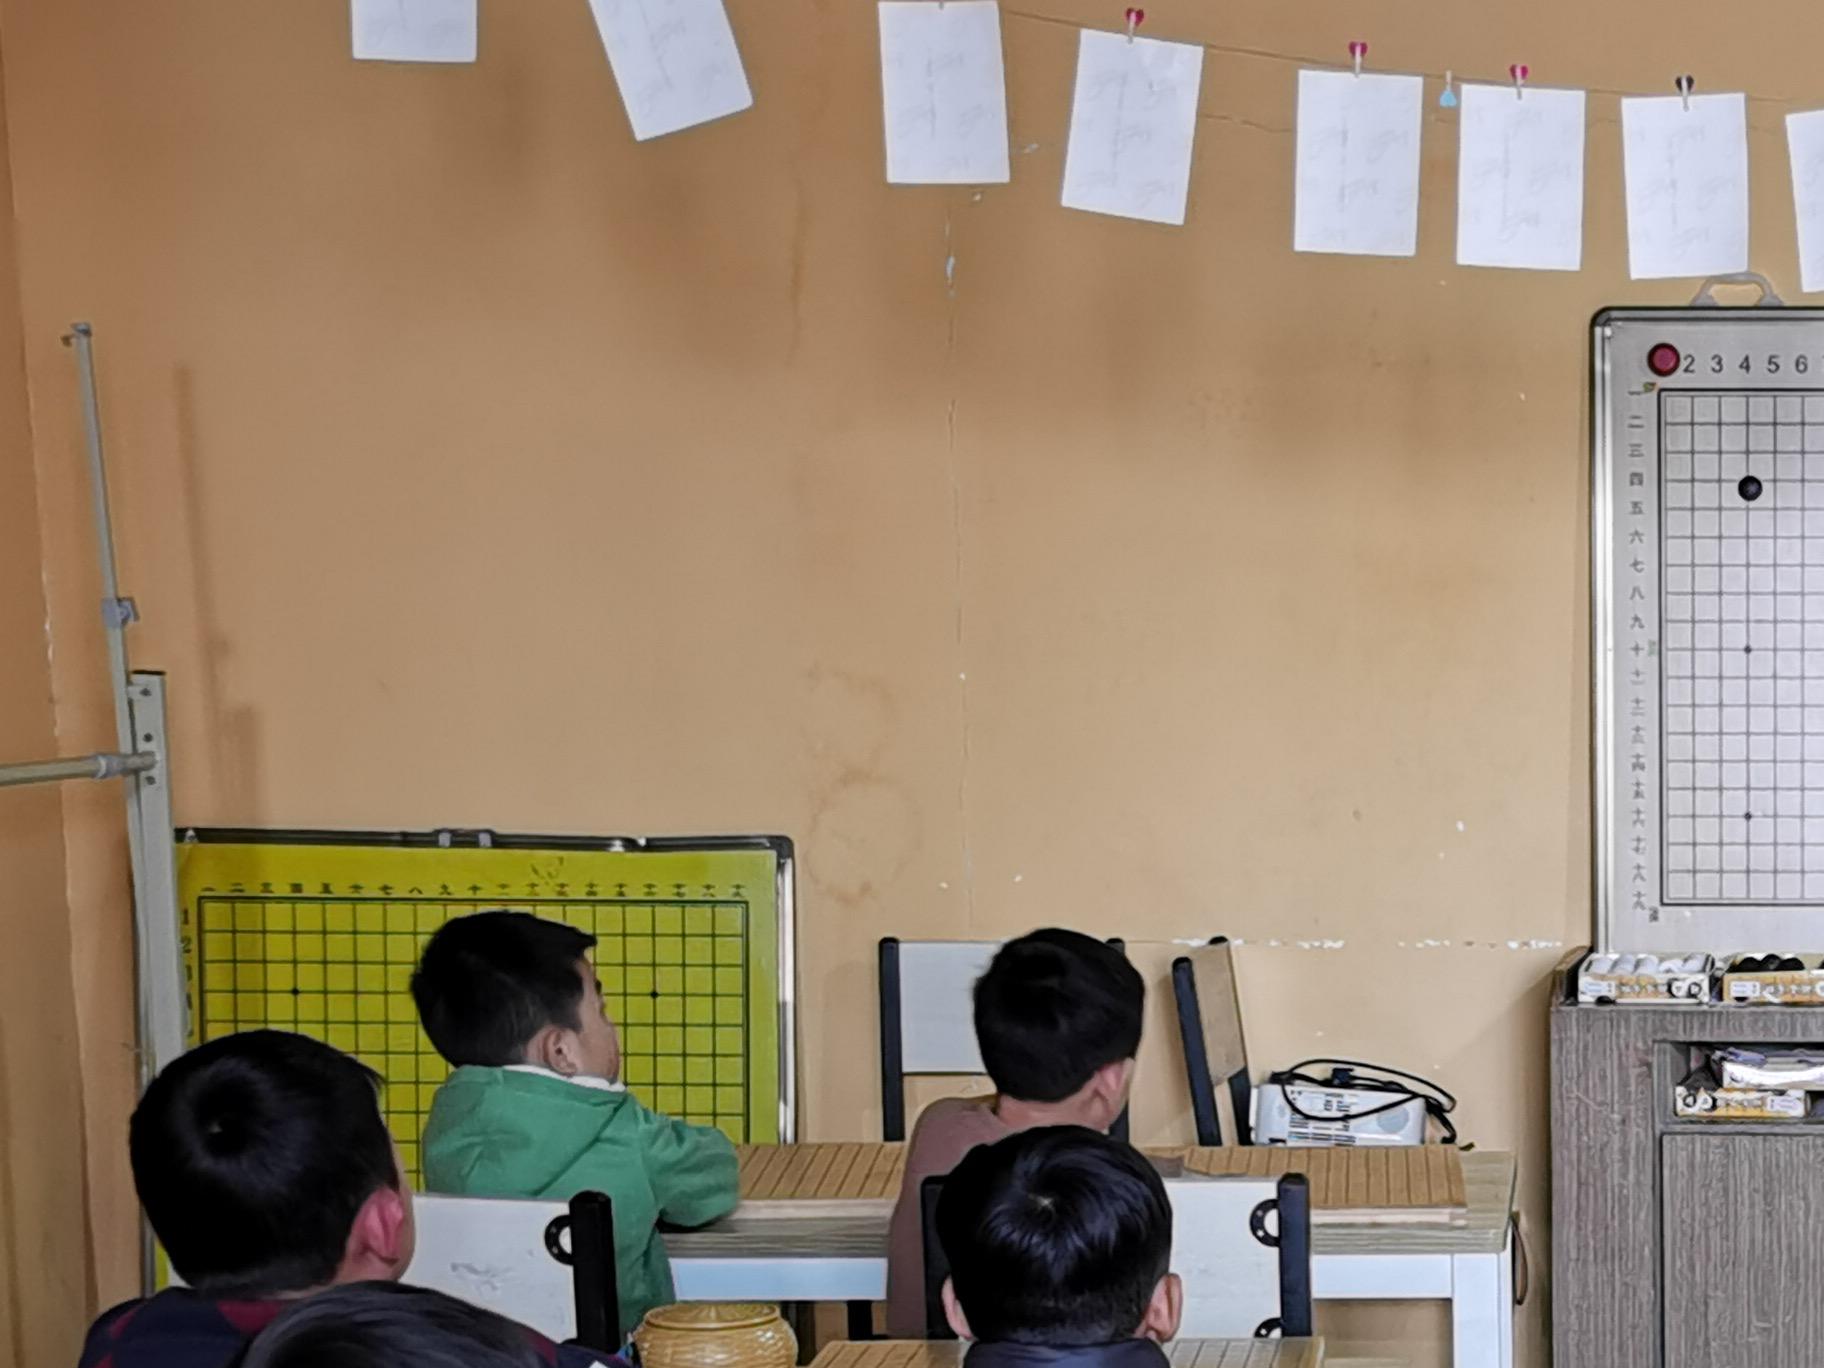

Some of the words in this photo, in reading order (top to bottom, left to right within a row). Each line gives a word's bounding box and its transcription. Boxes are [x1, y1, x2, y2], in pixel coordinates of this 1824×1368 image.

[1682, 354, 1696, 374] 2
[1711, 354, 1724, 374] 3
[1738, 354, 1751, 374] 4
[1766, 354, 1781, 374] 5
[1794, 354, 1809, 374] 6
[1627, 414, 1645, 429] 二
[1627, 443, 1645, 458] 三
[1629, 471, 1644, 487] 四
[1629, 500, 1645, 515] 五
[1629, 529, 1644, 544] 六
[1629, 557, 1644, 573] 七
[1629, 585, 1645, 601] 八
[1630, 614, 1645, 629] 九
[1630, 643, 1644, 656] 十
